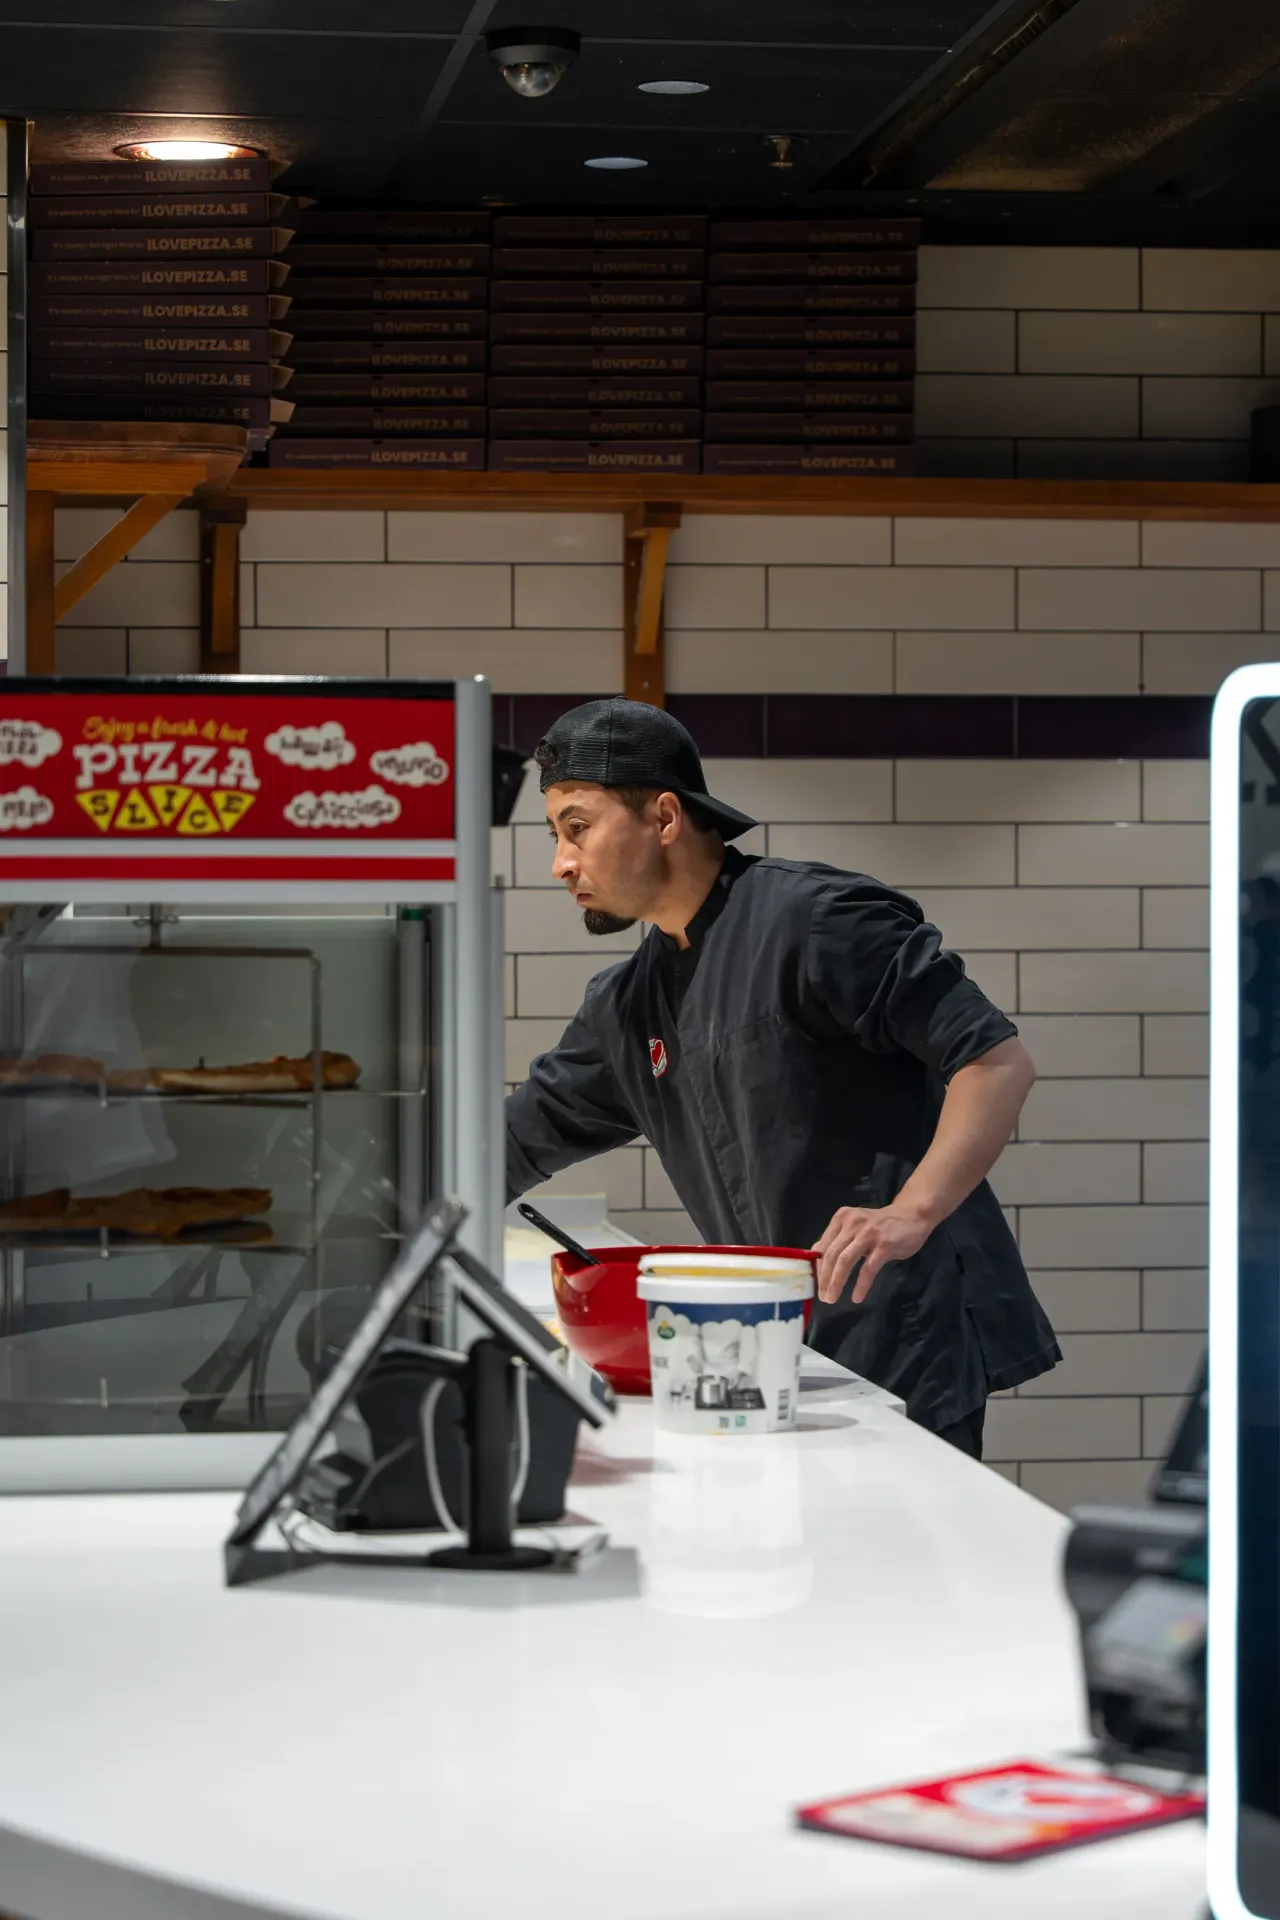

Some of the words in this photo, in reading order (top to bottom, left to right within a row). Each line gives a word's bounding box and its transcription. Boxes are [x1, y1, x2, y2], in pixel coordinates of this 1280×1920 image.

[145, 168, 251, 183] ILOVEPIZZA.SE
[142, 203, 248, 217] ILOVEPIZZA.SE
[147, 237, 253, 251] ILOVEPIZZA.SE
[142, 270, 248, 284] ILOVEPIZZA.SE
[142, 305, 249, 317] ILOVEPIZZA.SE
[144, 338, 251, 352] ILOVEPIZZA.SE
[144, 372, 252, 387] ILOVEPIZZA.SE
[370, 451, 468, 463] ILOVEPIZZA.SE
[588, 454, 683, 466] ILOVEPIZZA.SE
[82, 715, 136, 743] Enjoy
[136, 721, 149, 734] a
[151, 714, 198, 740] fresh
[218, 723, 248, 743] hot
[72, 741, 262, 791] PIZZA
[90, 787, 245, 829] SLICE
